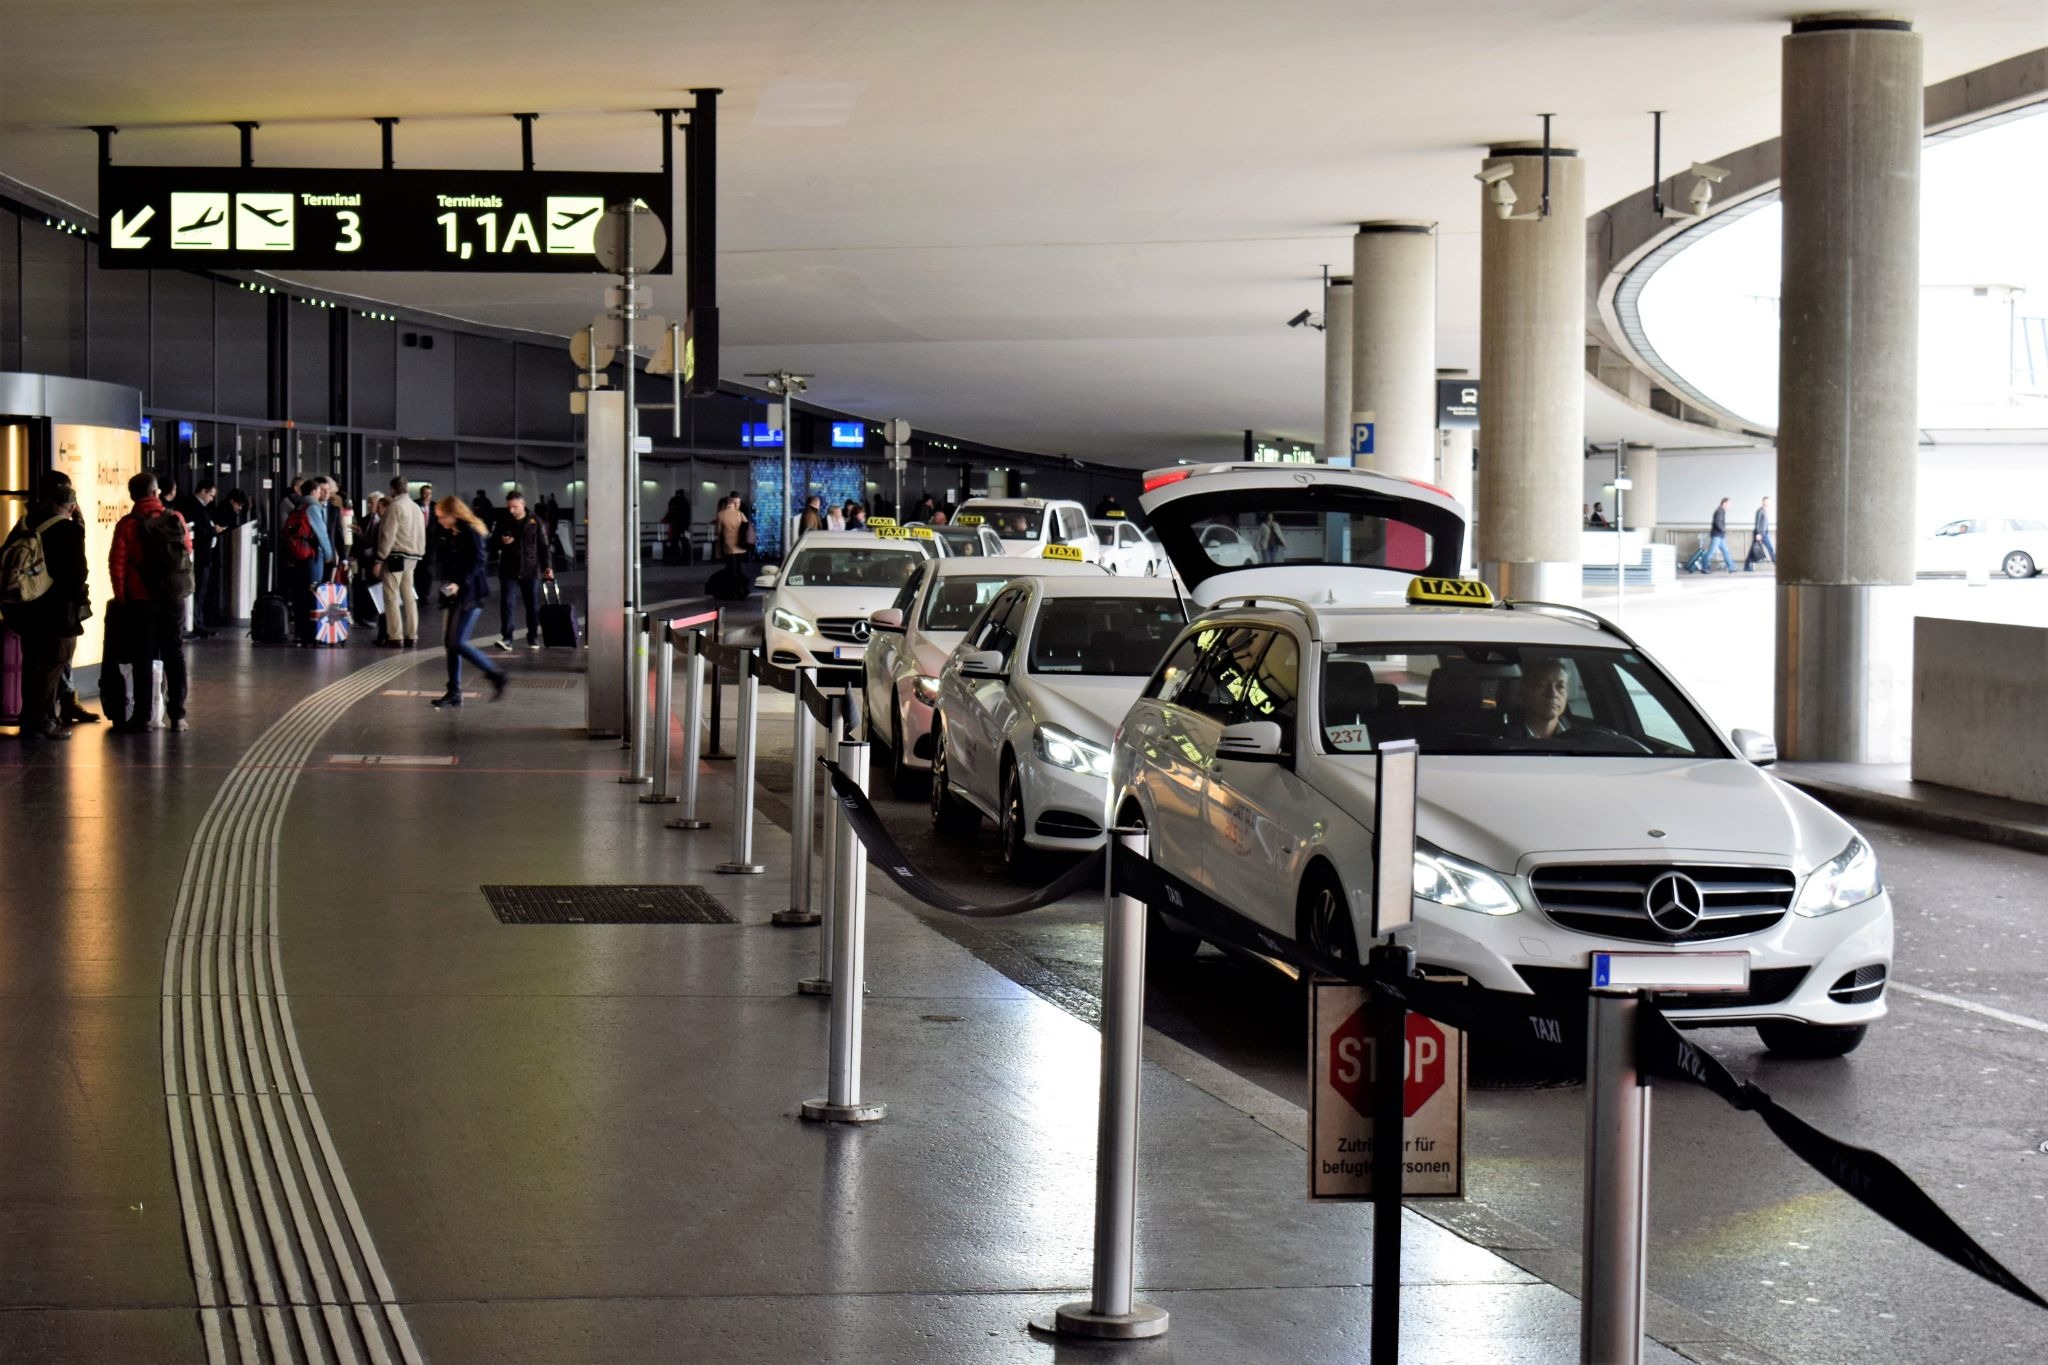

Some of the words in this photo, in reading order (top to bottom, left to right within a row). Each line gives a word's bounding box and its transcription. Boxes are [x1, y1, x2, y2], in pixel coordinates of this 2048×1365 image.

[301, 193, 361, 206] Terminal
[437, 194, 503, 208] Terminals
[335, 210, 362, 251] 3
[1356, 426, 1369, 452] P
[880, 527, 906, 537] TAXI
[1050, 546, 1080, 558] TAXI
[1423, 579, 1483, 597] TAXI
[1331, 729, 1363, 744] 237
[1165, 884, 1184, 908] TAXI
[1598, 974, 1606, 983] A
[1529, 1016, 1562, 1044] TAXI
[1415, 1136, 1436, 1151] für
